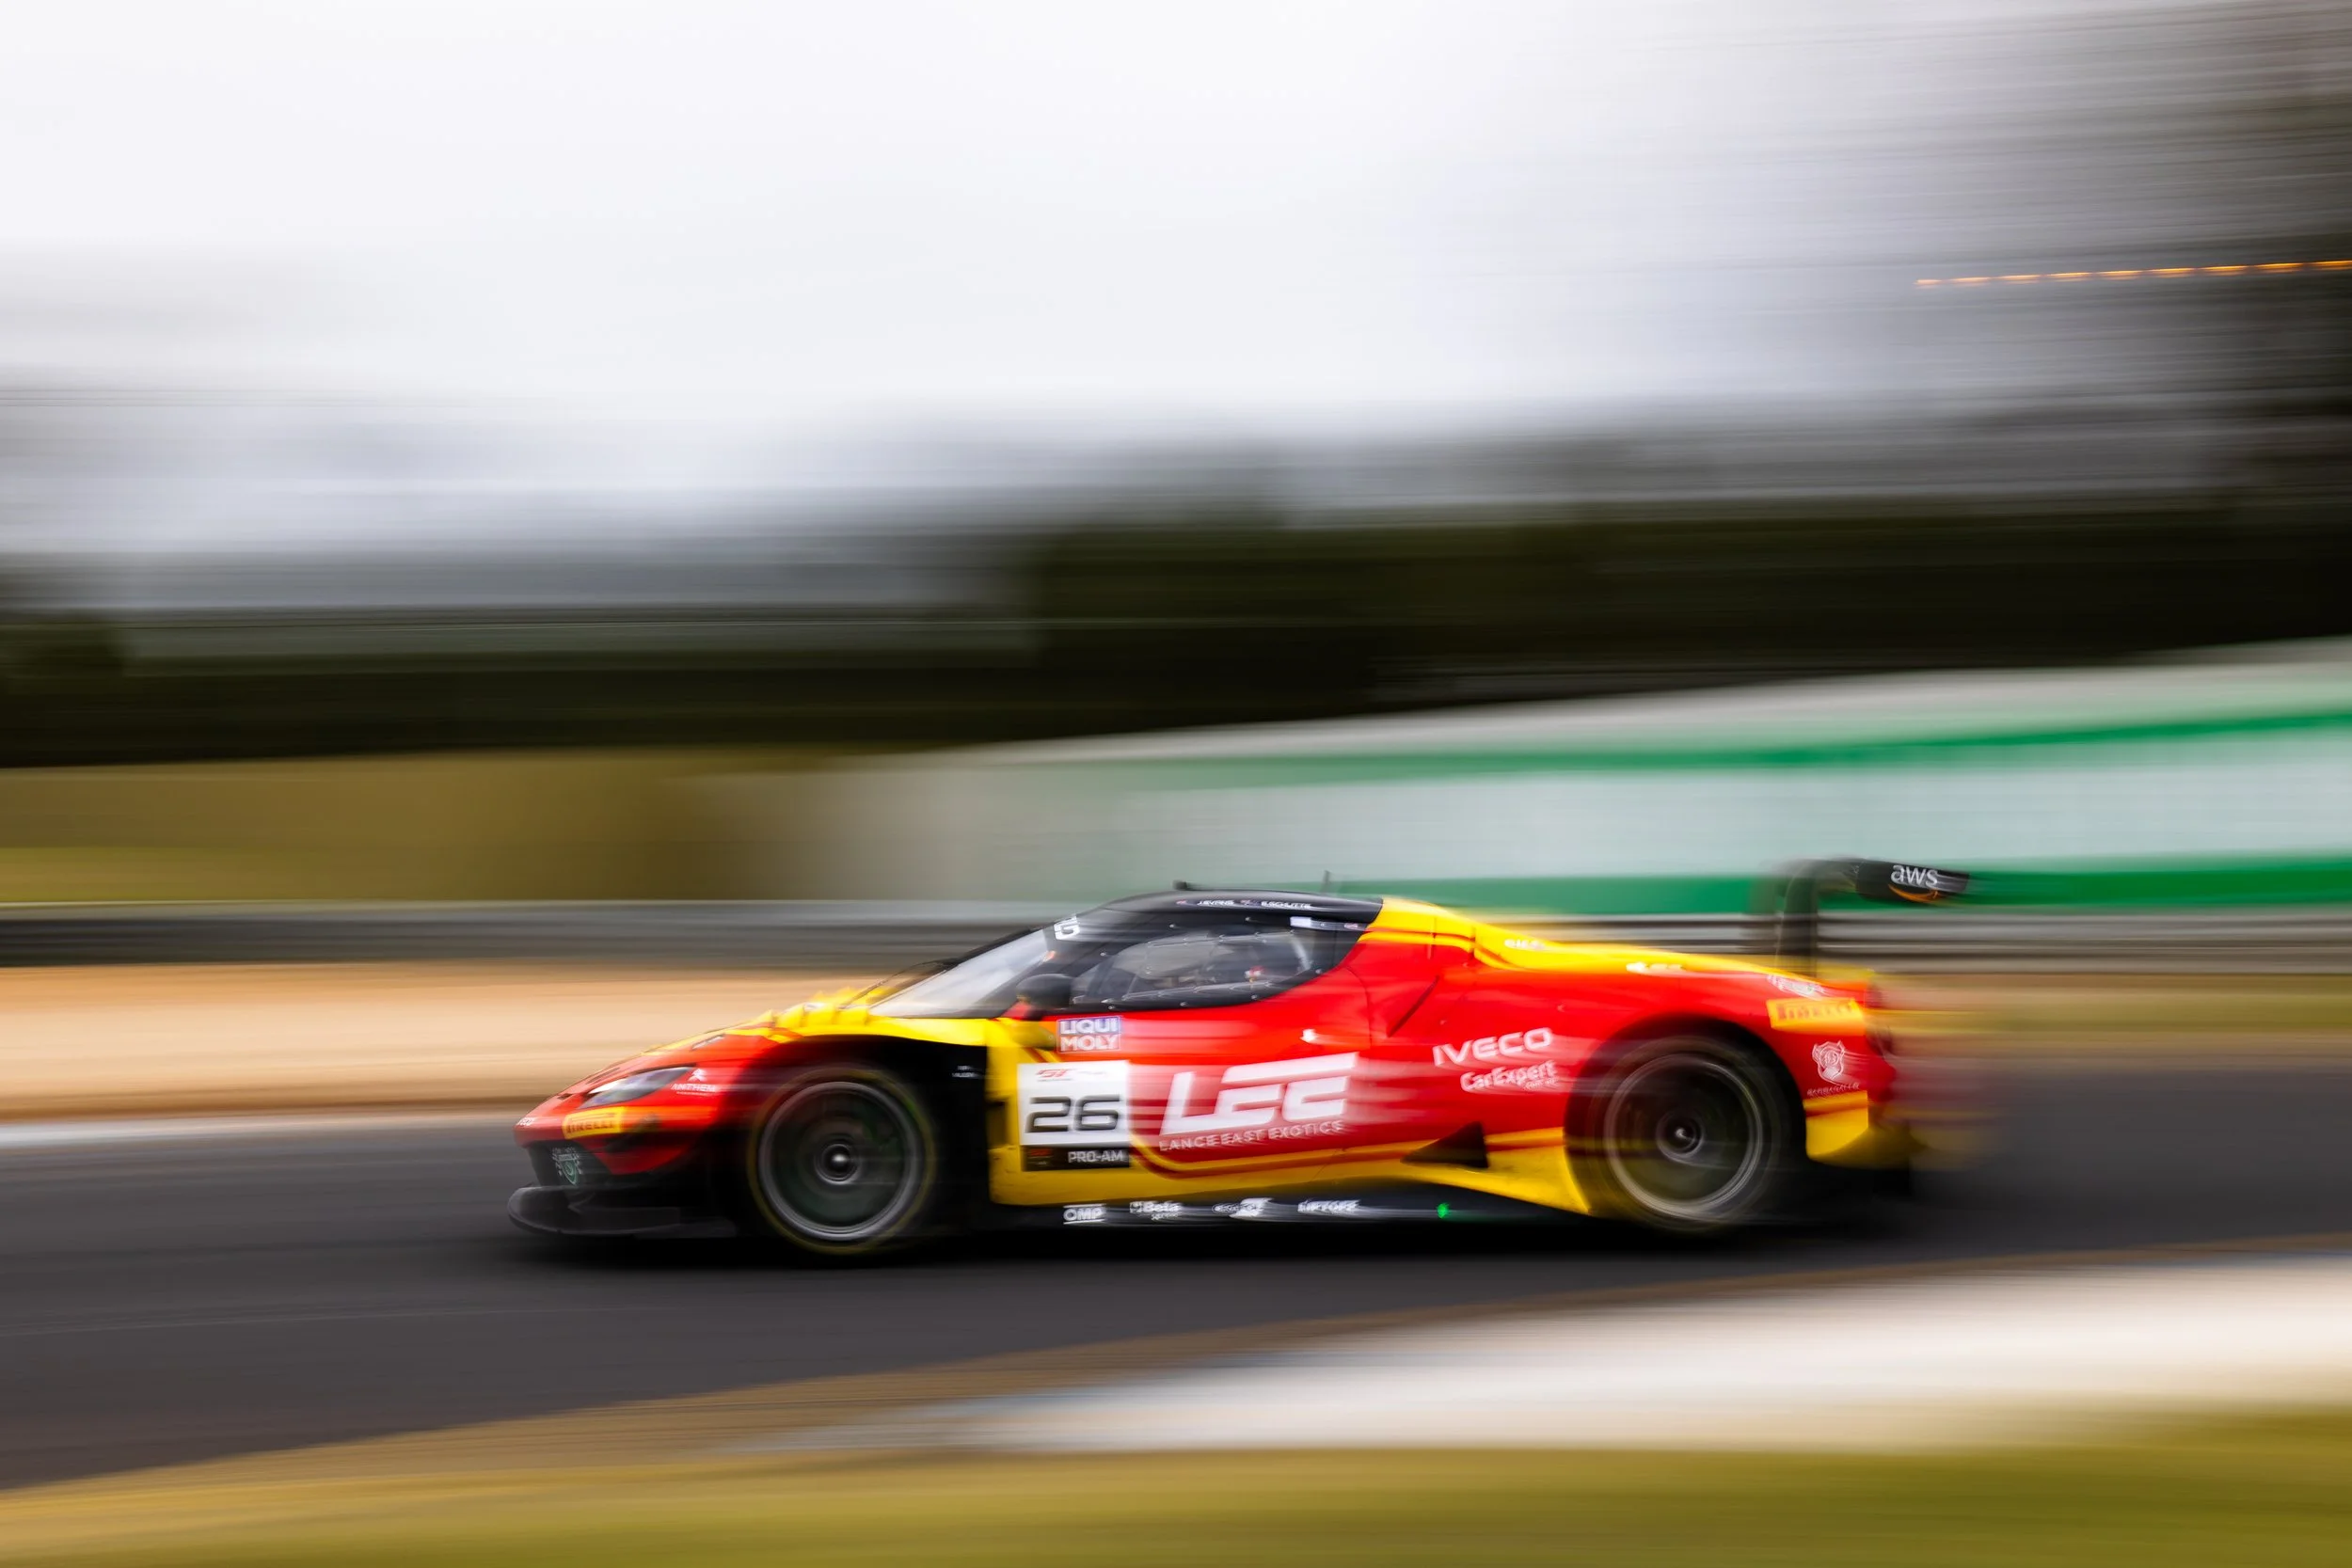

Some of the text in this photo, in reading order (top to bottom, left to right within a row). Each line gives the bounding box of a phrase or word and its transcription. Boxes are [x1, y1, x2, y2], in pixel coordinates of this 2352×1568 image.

[1890, 864, 1938, 886] aws
[1060, 1019, 1120, 1034] LIQUI
[1061, 1035, 1120, 1051] MOLY
[1433, 1027, 1552, 1067] IVECO
[1460, 1060, 1558, 1093] CarExpert
[1025, 1095, 1120, 1133] 26
[1159, 1120, 1344, 1151] LANCE EAST EXOTICS
[1068, 1150, 1124, 1164] PRO-AM
[1063, 1207, 1104, 1222] OMP
